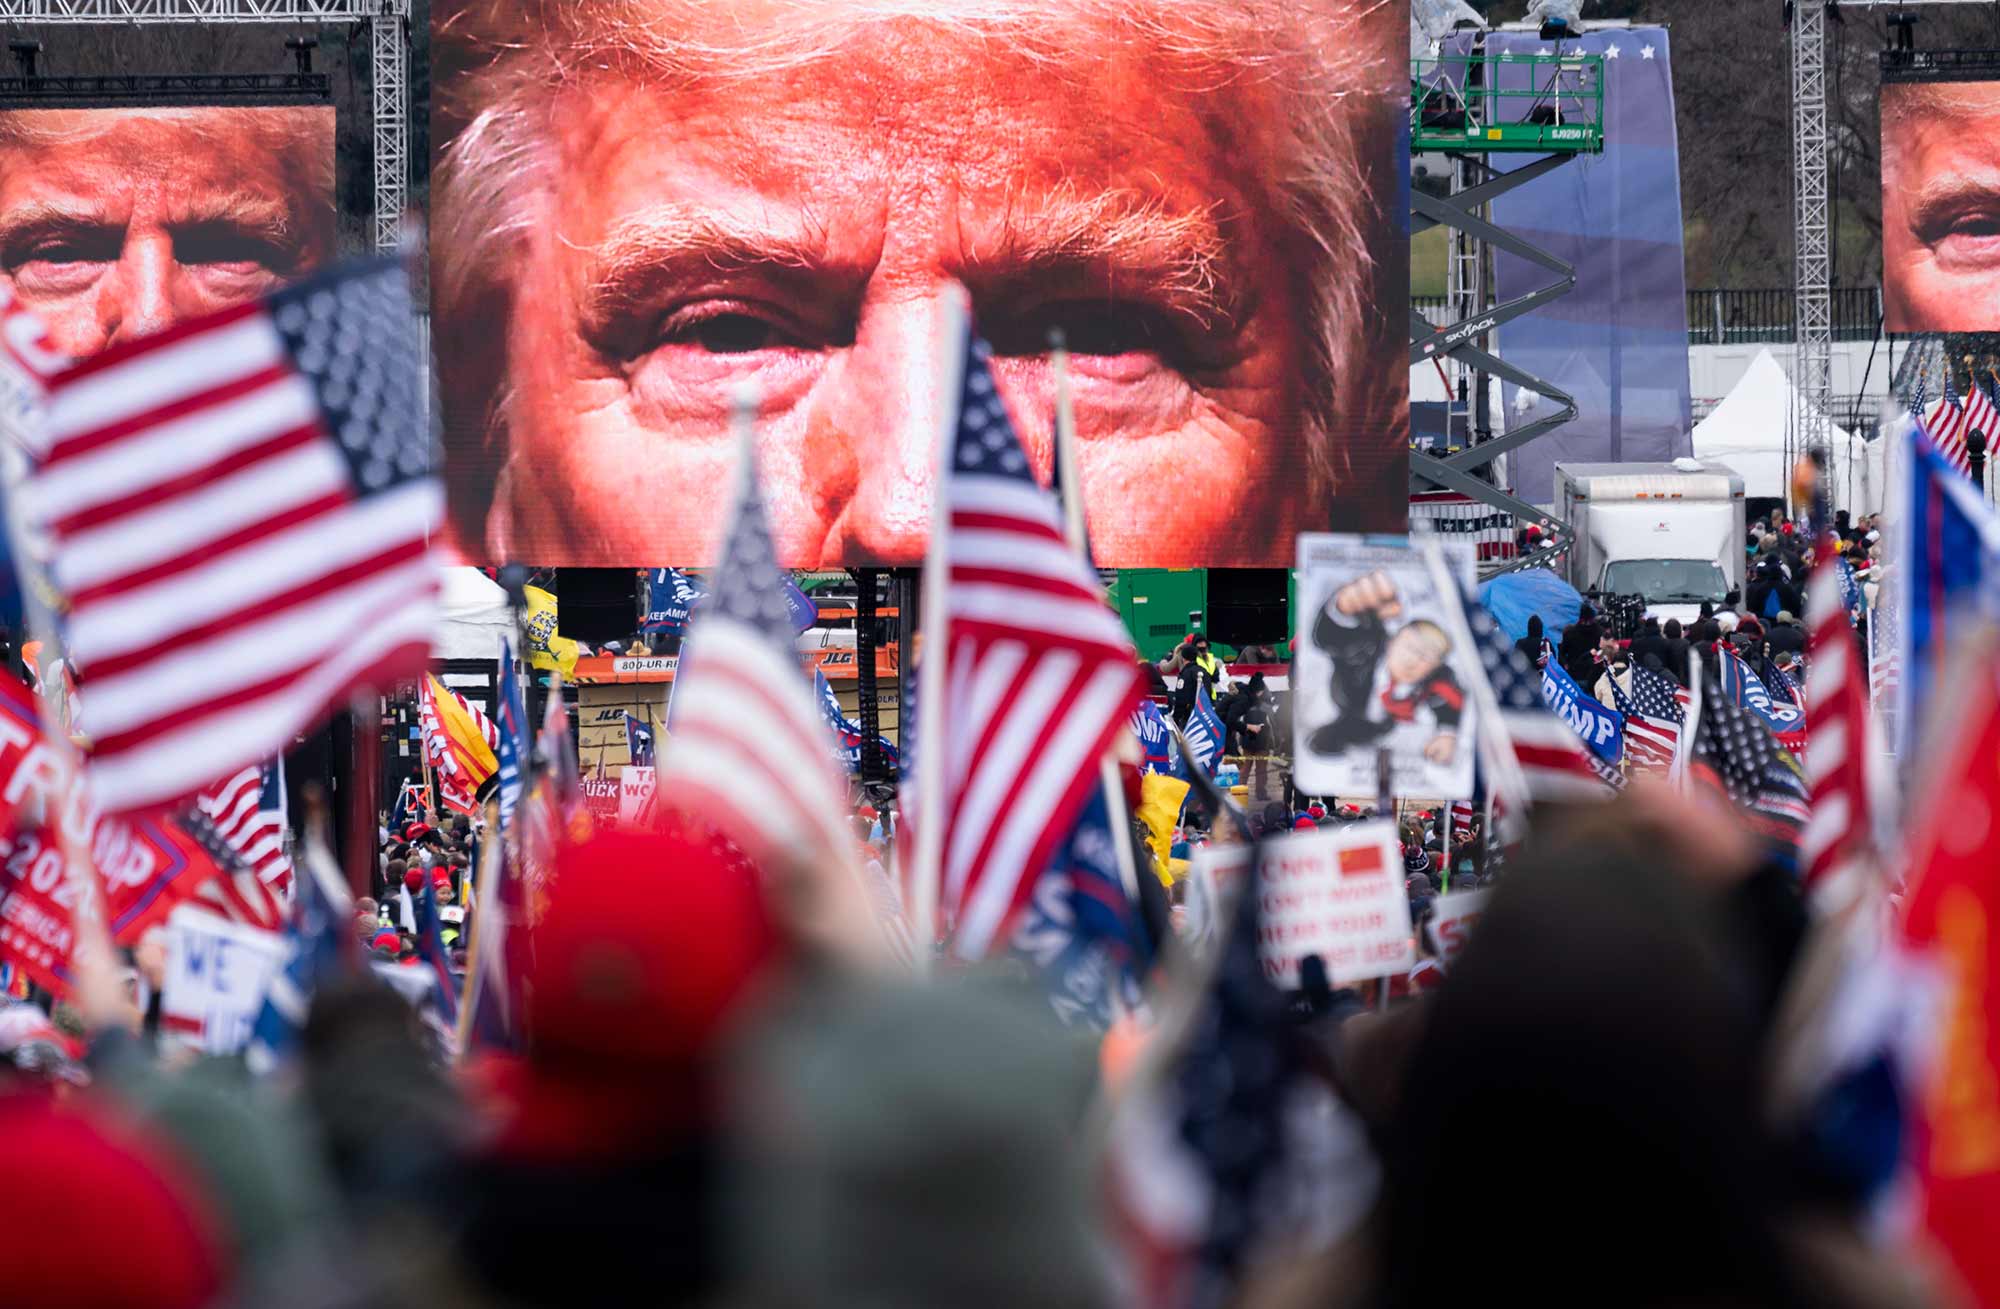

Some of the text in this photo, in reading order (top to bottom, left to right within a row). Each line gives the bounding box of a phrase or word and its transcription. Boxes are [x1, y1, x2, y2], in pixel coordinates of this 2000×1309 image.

[1445, 317, 1496, 344] SKYJACK
[822, 652, 853, 665] JLG
[595, 708, 624, 722] JLG
[1542, 670, 1616, 746] RUMP
[5, 832, 97, 918] 202
[183, 930, 234, 993] WE
